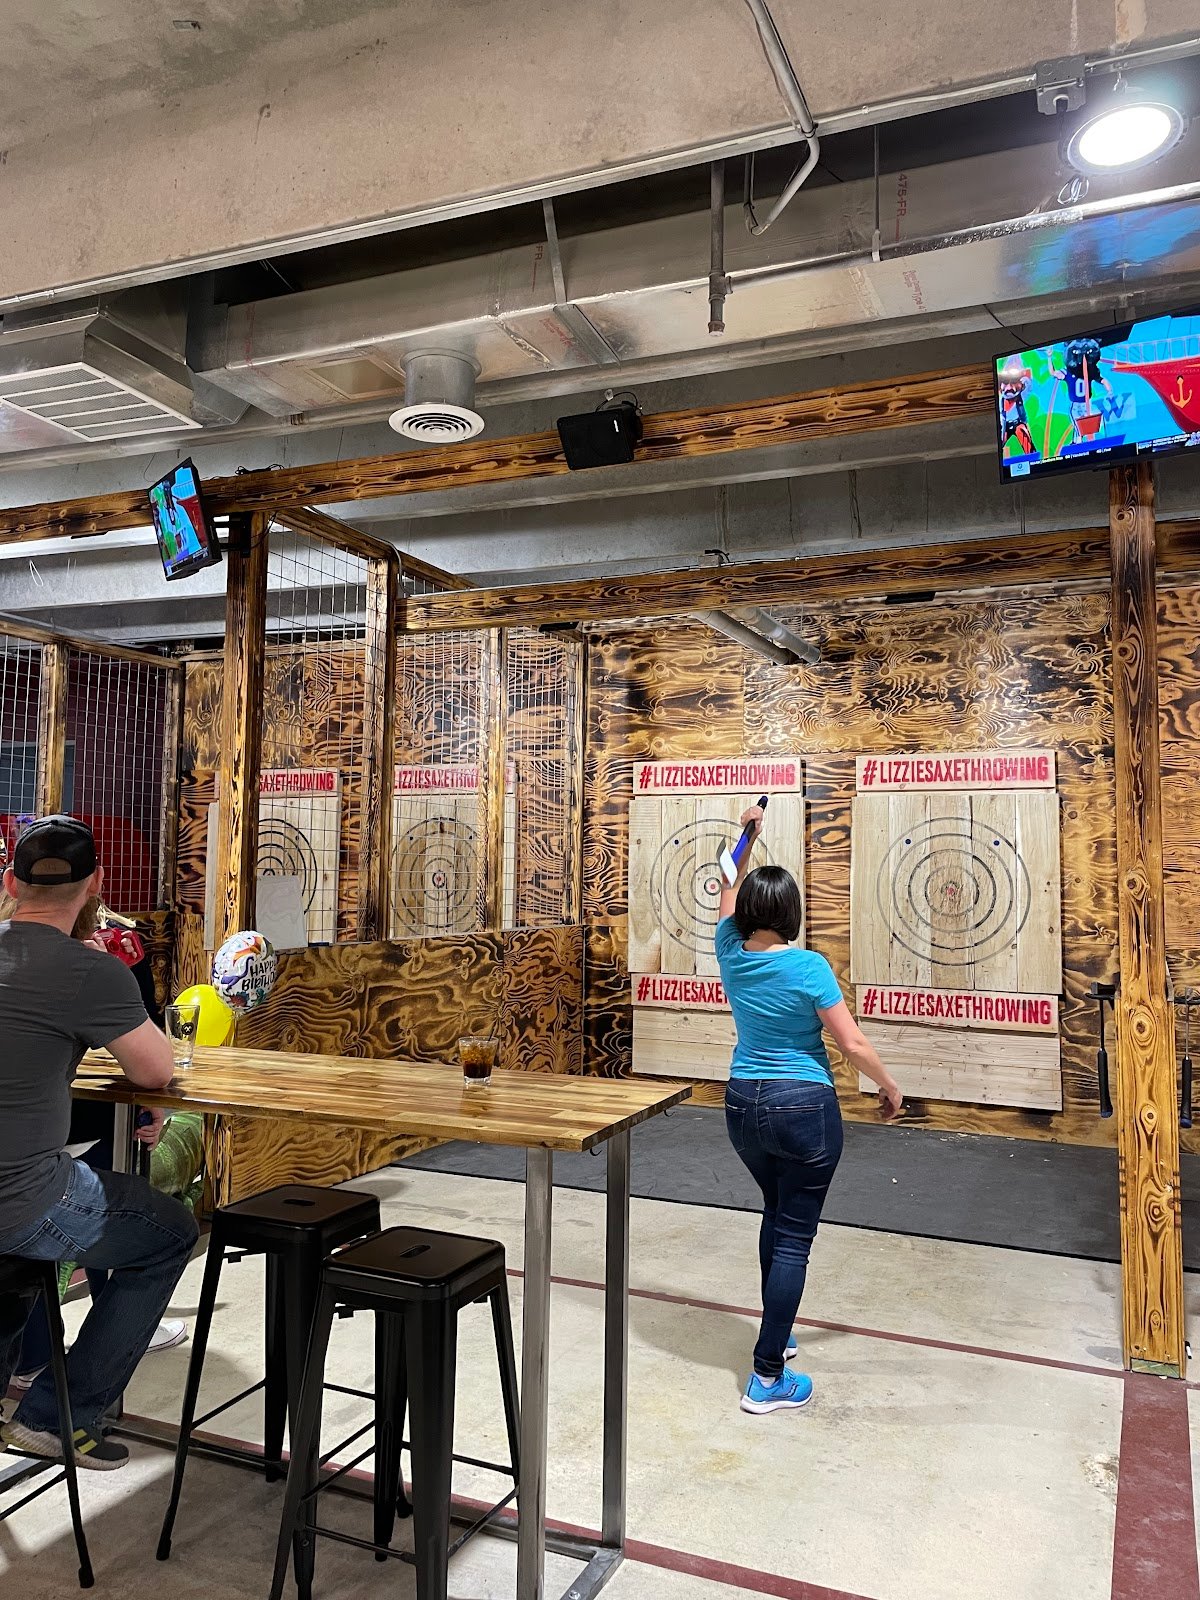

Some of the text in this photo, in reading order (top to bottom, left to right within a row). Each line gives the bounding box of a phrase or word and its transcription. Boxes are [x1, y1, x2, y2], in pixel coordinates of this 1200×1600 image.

[640, 763, 796, 789] #LIZZIESAXETHROWING
[862, 756, 1050, 786] #LIZZIESAXETHROWING
[863, 988, 1051, 1025] #LIZZIESAXETHROWING
